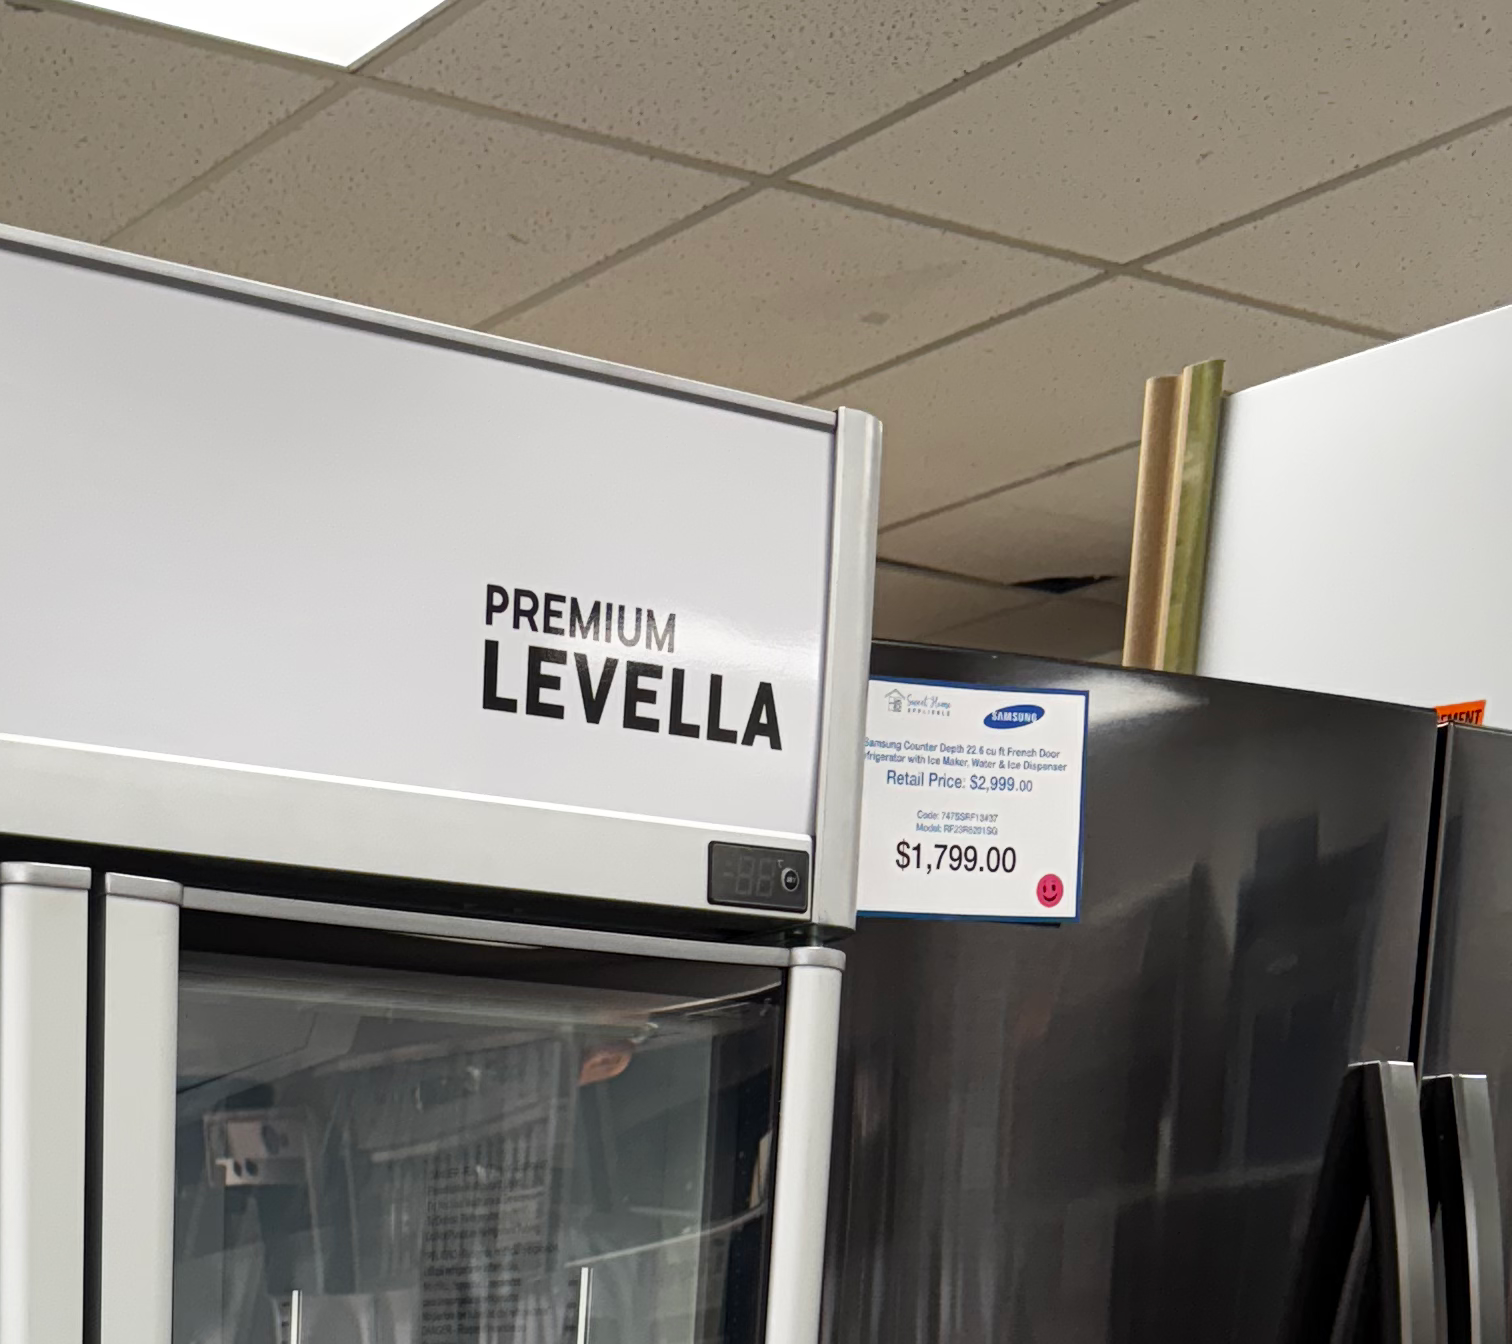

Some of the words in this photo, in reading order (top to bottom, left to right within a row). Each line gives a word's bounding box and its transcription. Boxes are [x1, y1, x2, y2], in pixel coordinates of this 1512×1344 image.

[485, 583, 676, 654] PREMIUM
[482, 639, 783, 751] LEVELLA
[991, 711, 1038, 723] SAMSUNG
[904, 741, 938, 752] Counter
[940, 743, 965, 755] Depth
[1007, 747, 1037, 758] French
[1039, 749, 1061, 759] Door
[908, 754, 926, 764] with
[971, 758, 996, 769] Water
[1023, 761, 1068, 772] Dispenser
[886, 769, 925, 787] Retail
[928, 772, 966, 789] Price:
[969, 774, 1033, 793] $2,999.00
[895, 838, 1017, 875] $1,799.00
